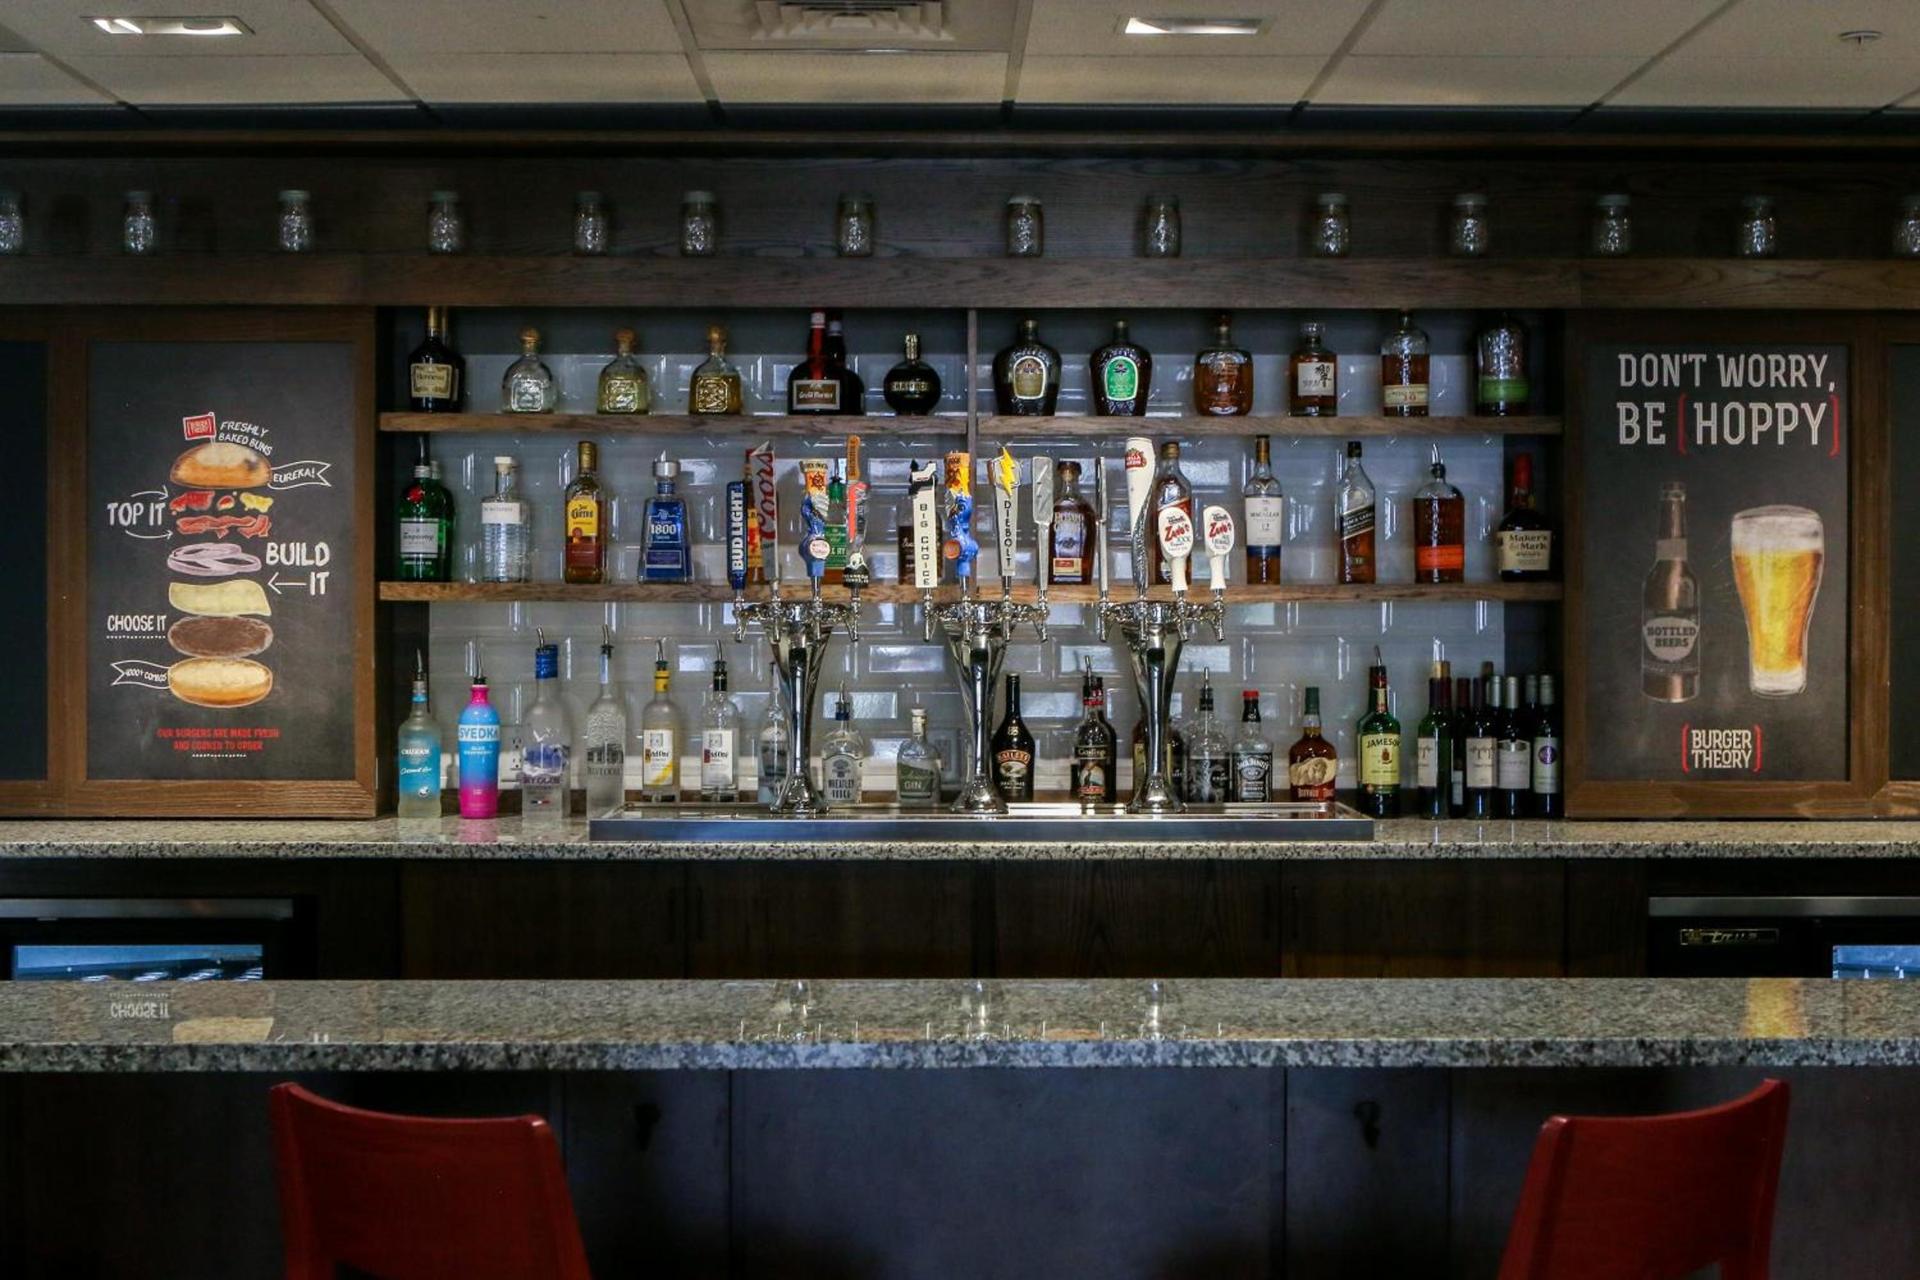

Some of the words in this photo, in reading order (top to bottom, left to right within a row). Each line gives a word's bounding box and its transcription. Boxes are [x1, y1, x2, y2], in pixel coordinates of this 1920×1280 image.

[1618, 353, 1707, 388] DON'T
[1717, 353, 1835, 392] WORRY,
[220, 421, 269, 438] FRESHLY
[1616, 402, 1666, 445] BE
[218, 432, 248, 445] BAKED
[249, 438, 273, 456] BUNS
[273, 468, 316, 483] EUREKA!
[757, 452, 776, 540] Coors
[106, 502, 144, 526] TOP
[150, 502, 166, 526] IT
[731, 490, 744, 536] LIGHT
[920, 503, 929, 528] BIG
[651, 524, 677, 535] 1800
[1003, 500, 1013, 567] DIEBOLT
[265, 542, 331, 566] BUILD
[731, 537, 744, 571] BUD
[921, 536, 930, 586] CHOICE
[309, 571, 330, 595] IT
[107, 615, 154, 632] CHOOSE
[157, 615, 167, 631] IT
[1647, 627, 1697, 637] BOTTLED
[1655, 637, 1689, 648] BEERS
[1691, 730, 1752, 749] BURGER
[1691, 750, 1752, 769] THEORY
[905, 781, 921, 789] GIN
